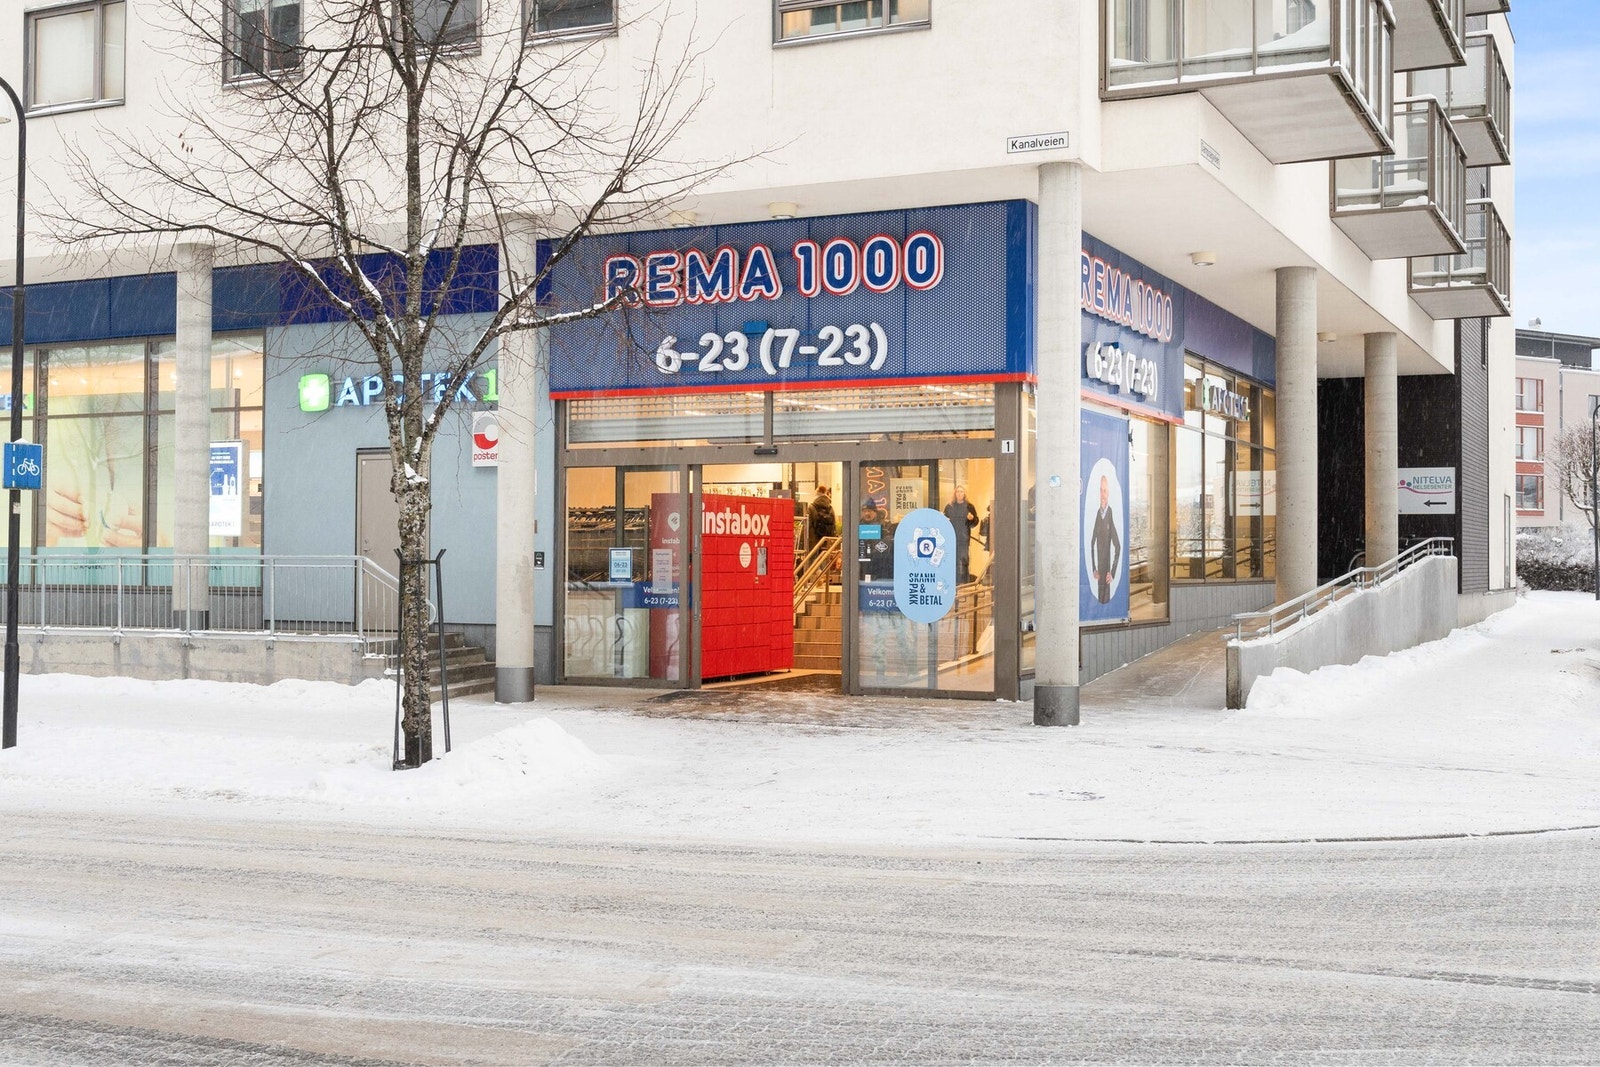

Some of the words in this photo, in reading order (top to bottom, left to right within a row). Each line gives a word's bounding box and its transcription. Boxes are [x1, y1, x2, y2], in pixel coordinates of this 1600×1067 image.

[1011, 136, 1065, 150] Kanalveien
[602, 242, 782, 308] REMA
[793, 230, 945, 298] 1000
[1081, 249, 1134, 325] REMA
[1136, 279, 1172, 342] 1000
[655, 332, 750, 375] 6-23
[760, 321, 888, 376] (7-23)
[1092, 341, 1122, 386] 6-23
[1126, 351, 1158, 402] (7-23)
[1006, 441, 1010, 452] 1
[1412, 476, 1453, 484] NITELVA
[702, 502, 770, 536] instabox
[867, 588, 894, 596] Velkom
[908, 583, 919, 606] PAKK
[644, 597, 659, 605] 6-23
[660, 597, 679, 605] (7-23)
[868, 599, 885, 607] 6-23
[919, 595, 943, 605] BETAL
